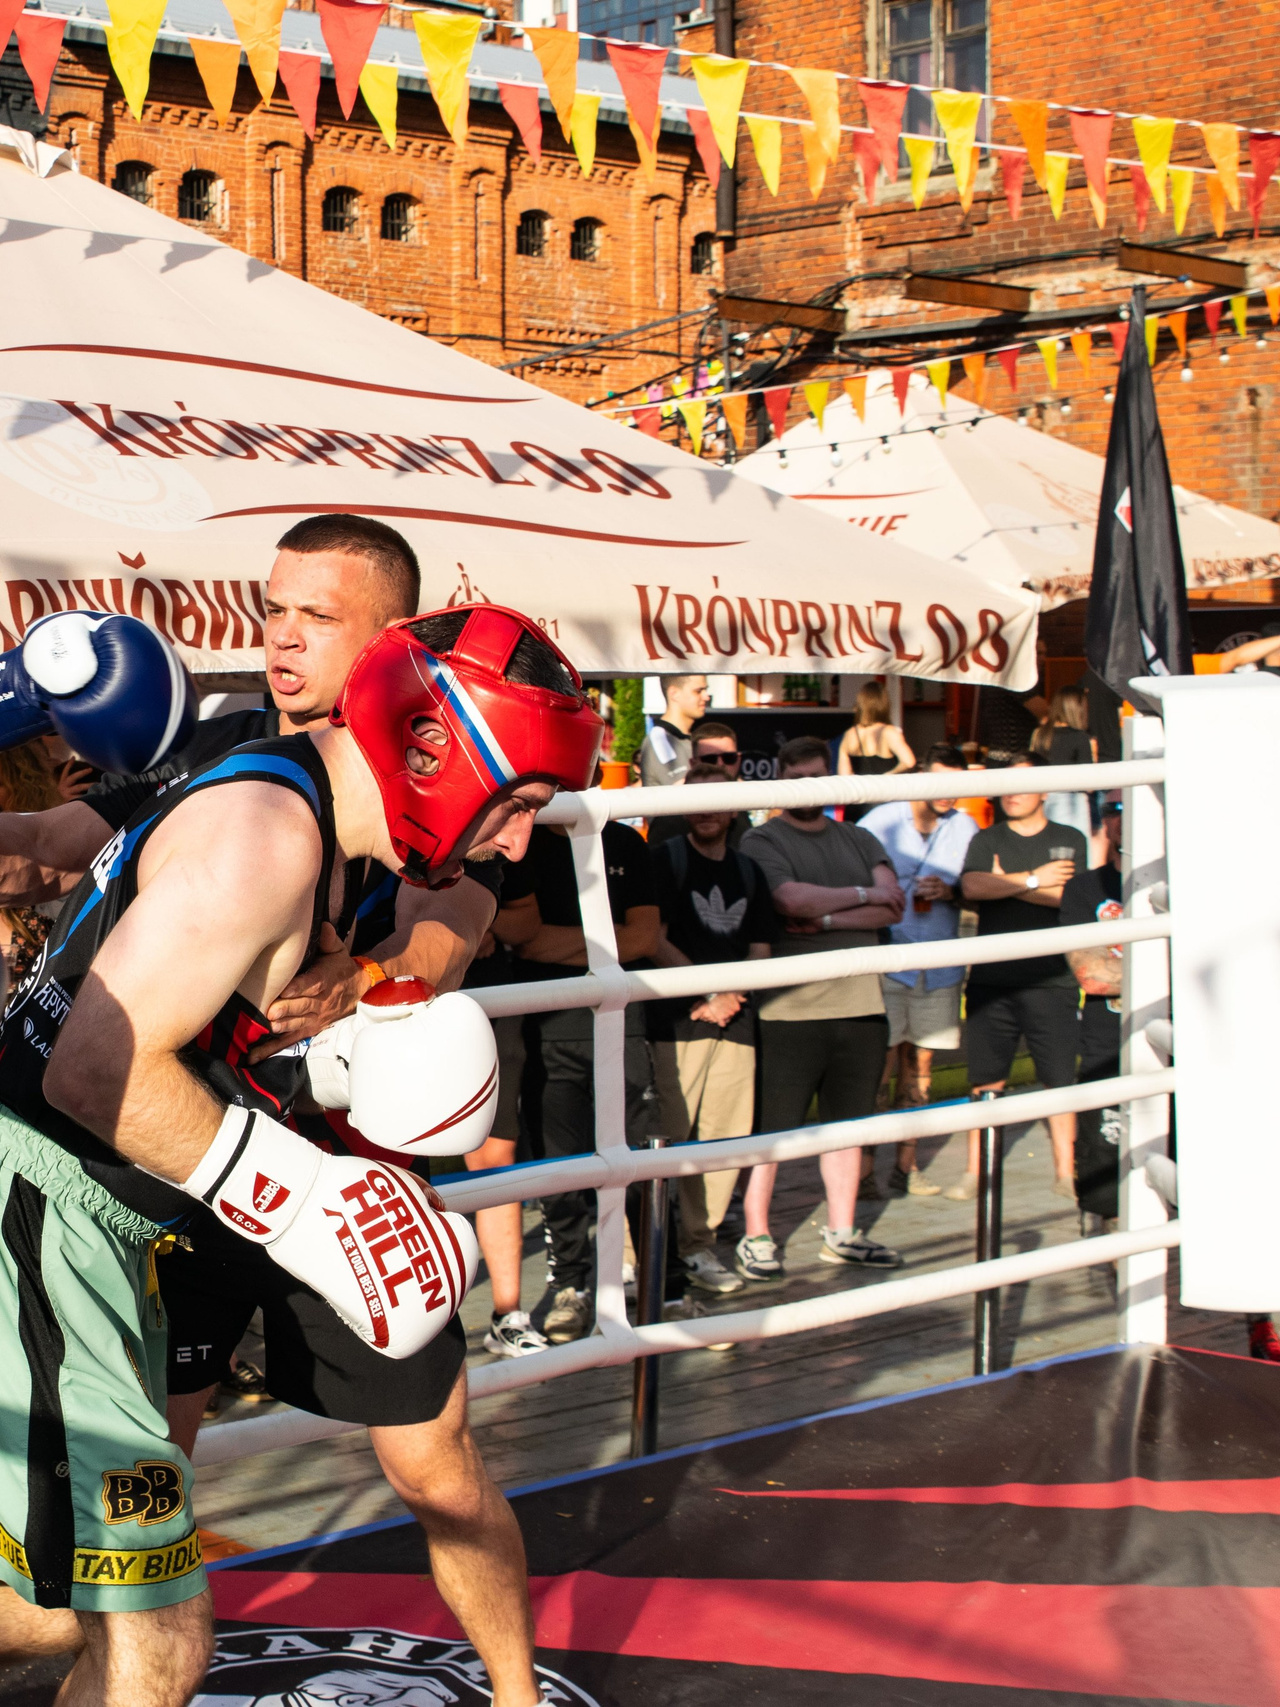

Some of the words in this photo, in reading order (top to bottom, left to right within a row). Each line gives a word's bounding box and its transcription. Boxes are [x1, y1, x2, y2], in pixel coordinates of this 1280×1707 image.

[510, 441, 672, 500] 0.0
[340, 1178, 414, 1309] HILL
[341, 1235, 355, 1251] BE
[348, 1248, 367, 1276] YOUR
[359, 1274, 377, 1298] BEST
[368, 1297, 384, 1318] SELF
[366, 1169, 446, 1313] GREEN
[75, 1552, 137, 1580] TAY
